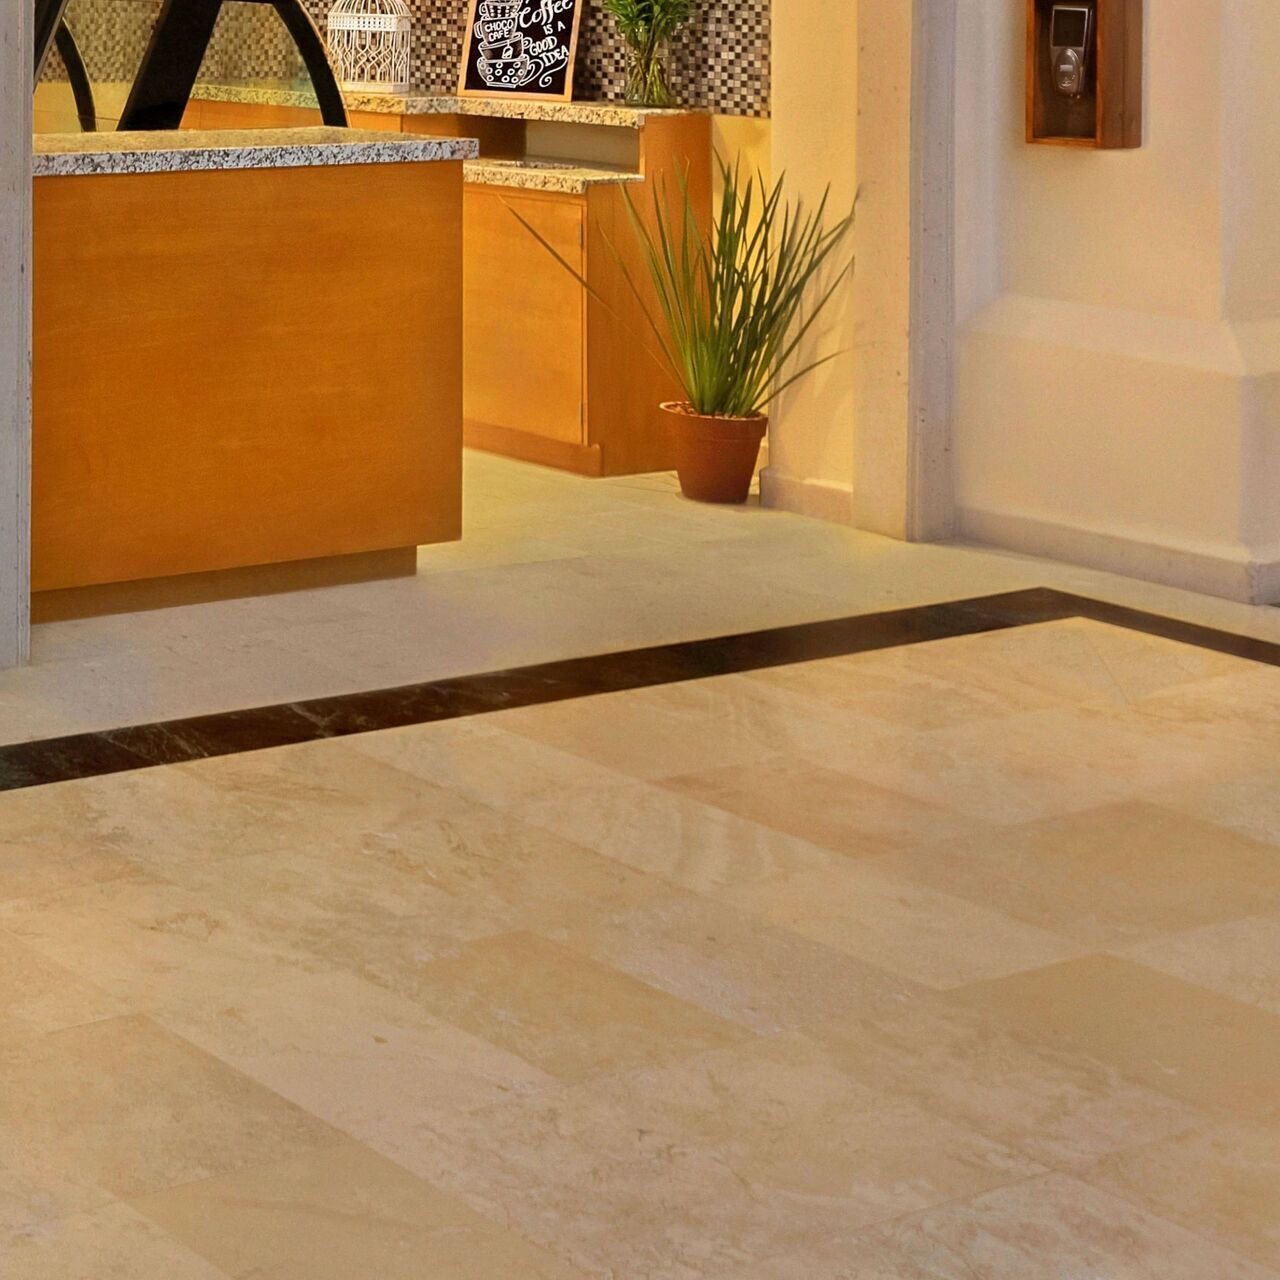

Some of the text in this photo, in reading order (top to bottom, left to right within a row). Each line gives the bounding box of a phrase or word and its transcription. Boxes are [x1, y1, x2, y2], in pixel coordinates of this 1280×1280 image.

[485, 19, 514, 32] CHOCO
[543, 21, 566, 35] IS A
[529, 36, 557, 56] GOOD
[539, 45, 569, 67] IDEA
